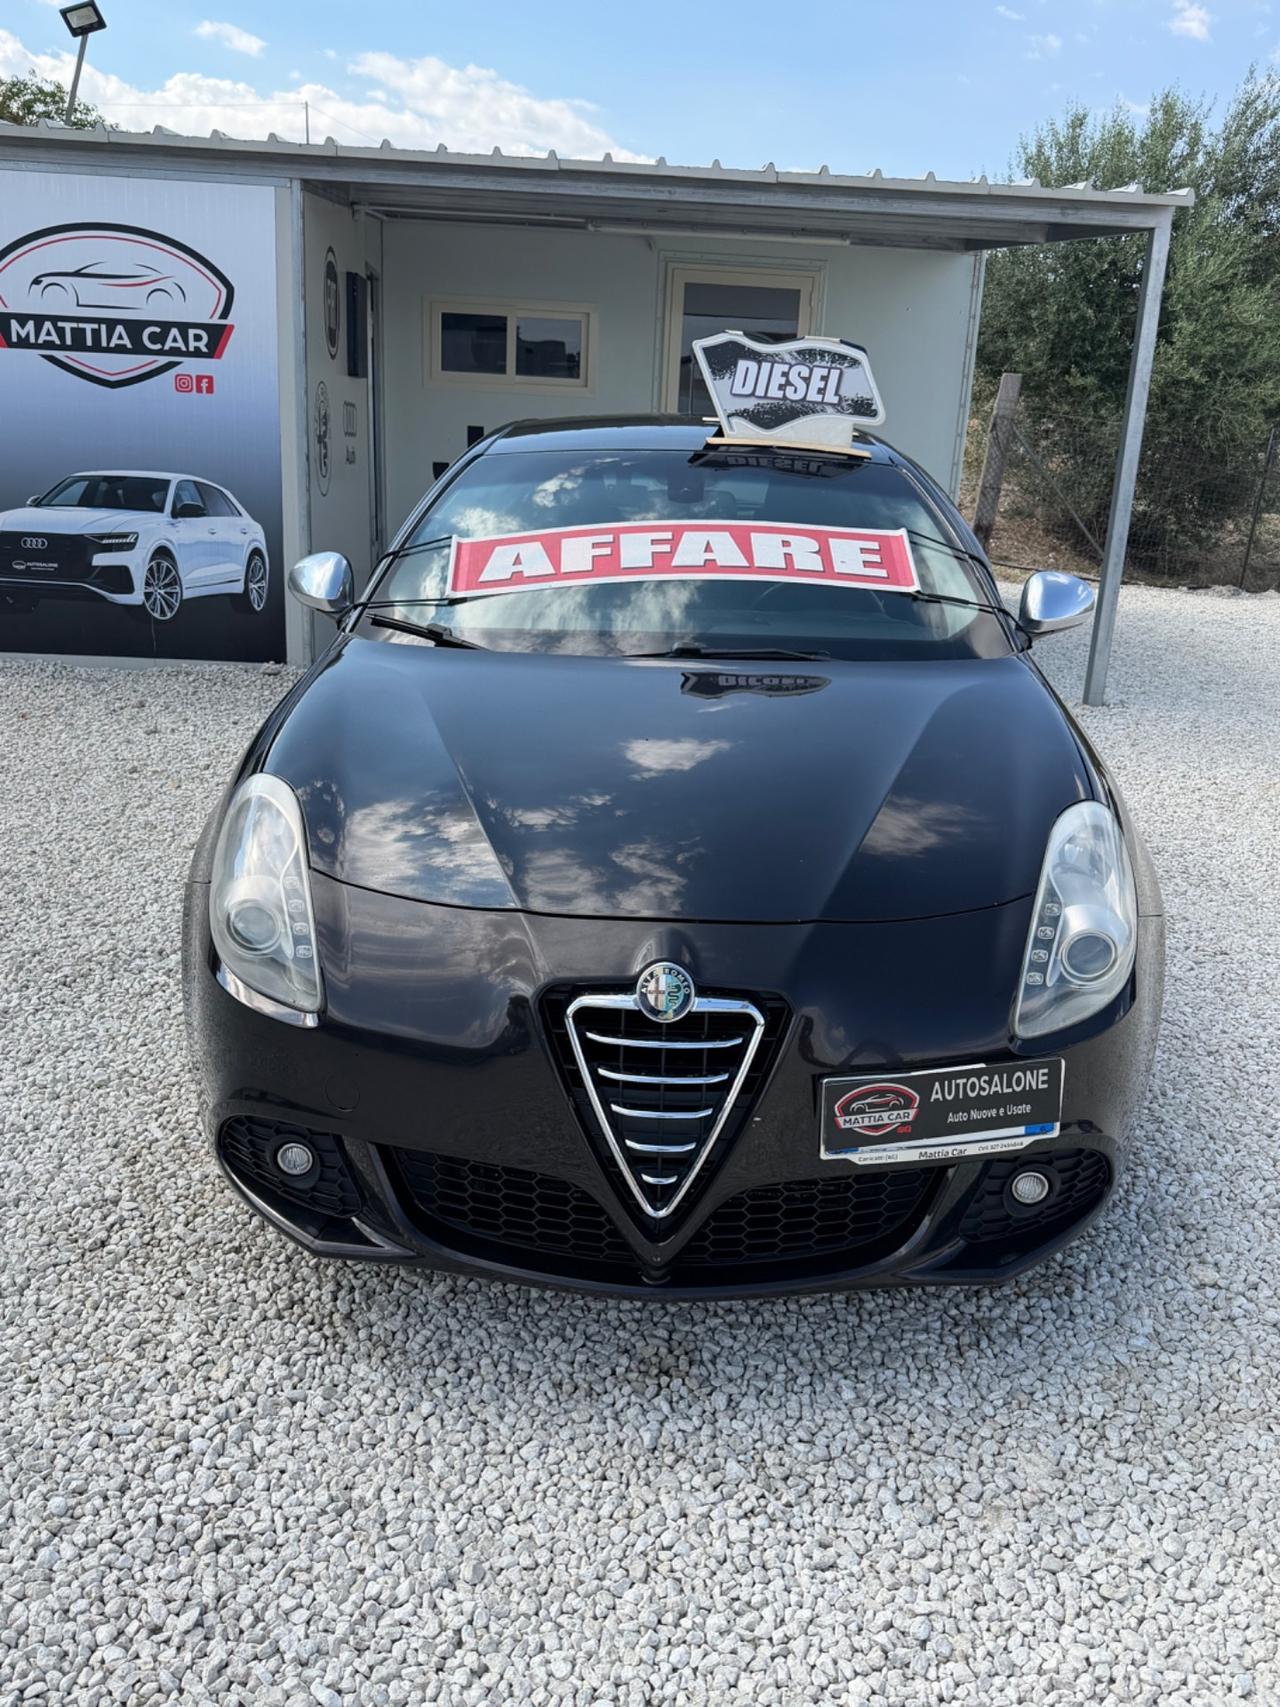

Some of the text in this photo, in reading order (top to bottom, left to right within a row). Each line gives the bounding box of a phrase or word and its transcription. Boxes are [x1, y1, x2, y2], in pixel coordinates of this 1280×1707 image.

[10, 318, 209, 353] MATTIA CAR
[731, 360, 842, 404] DIESEL
[478, 530, 889, 583] AFFARE
[930, 1068, 1049, 1102] AUTOSALONE
[843, 1111, 911, 1127] MATTIA CAR
[947, 1103, 1032, 1124] Auto Nuove e Usate
[918, 1147, 968, 1160] Mattia Car
